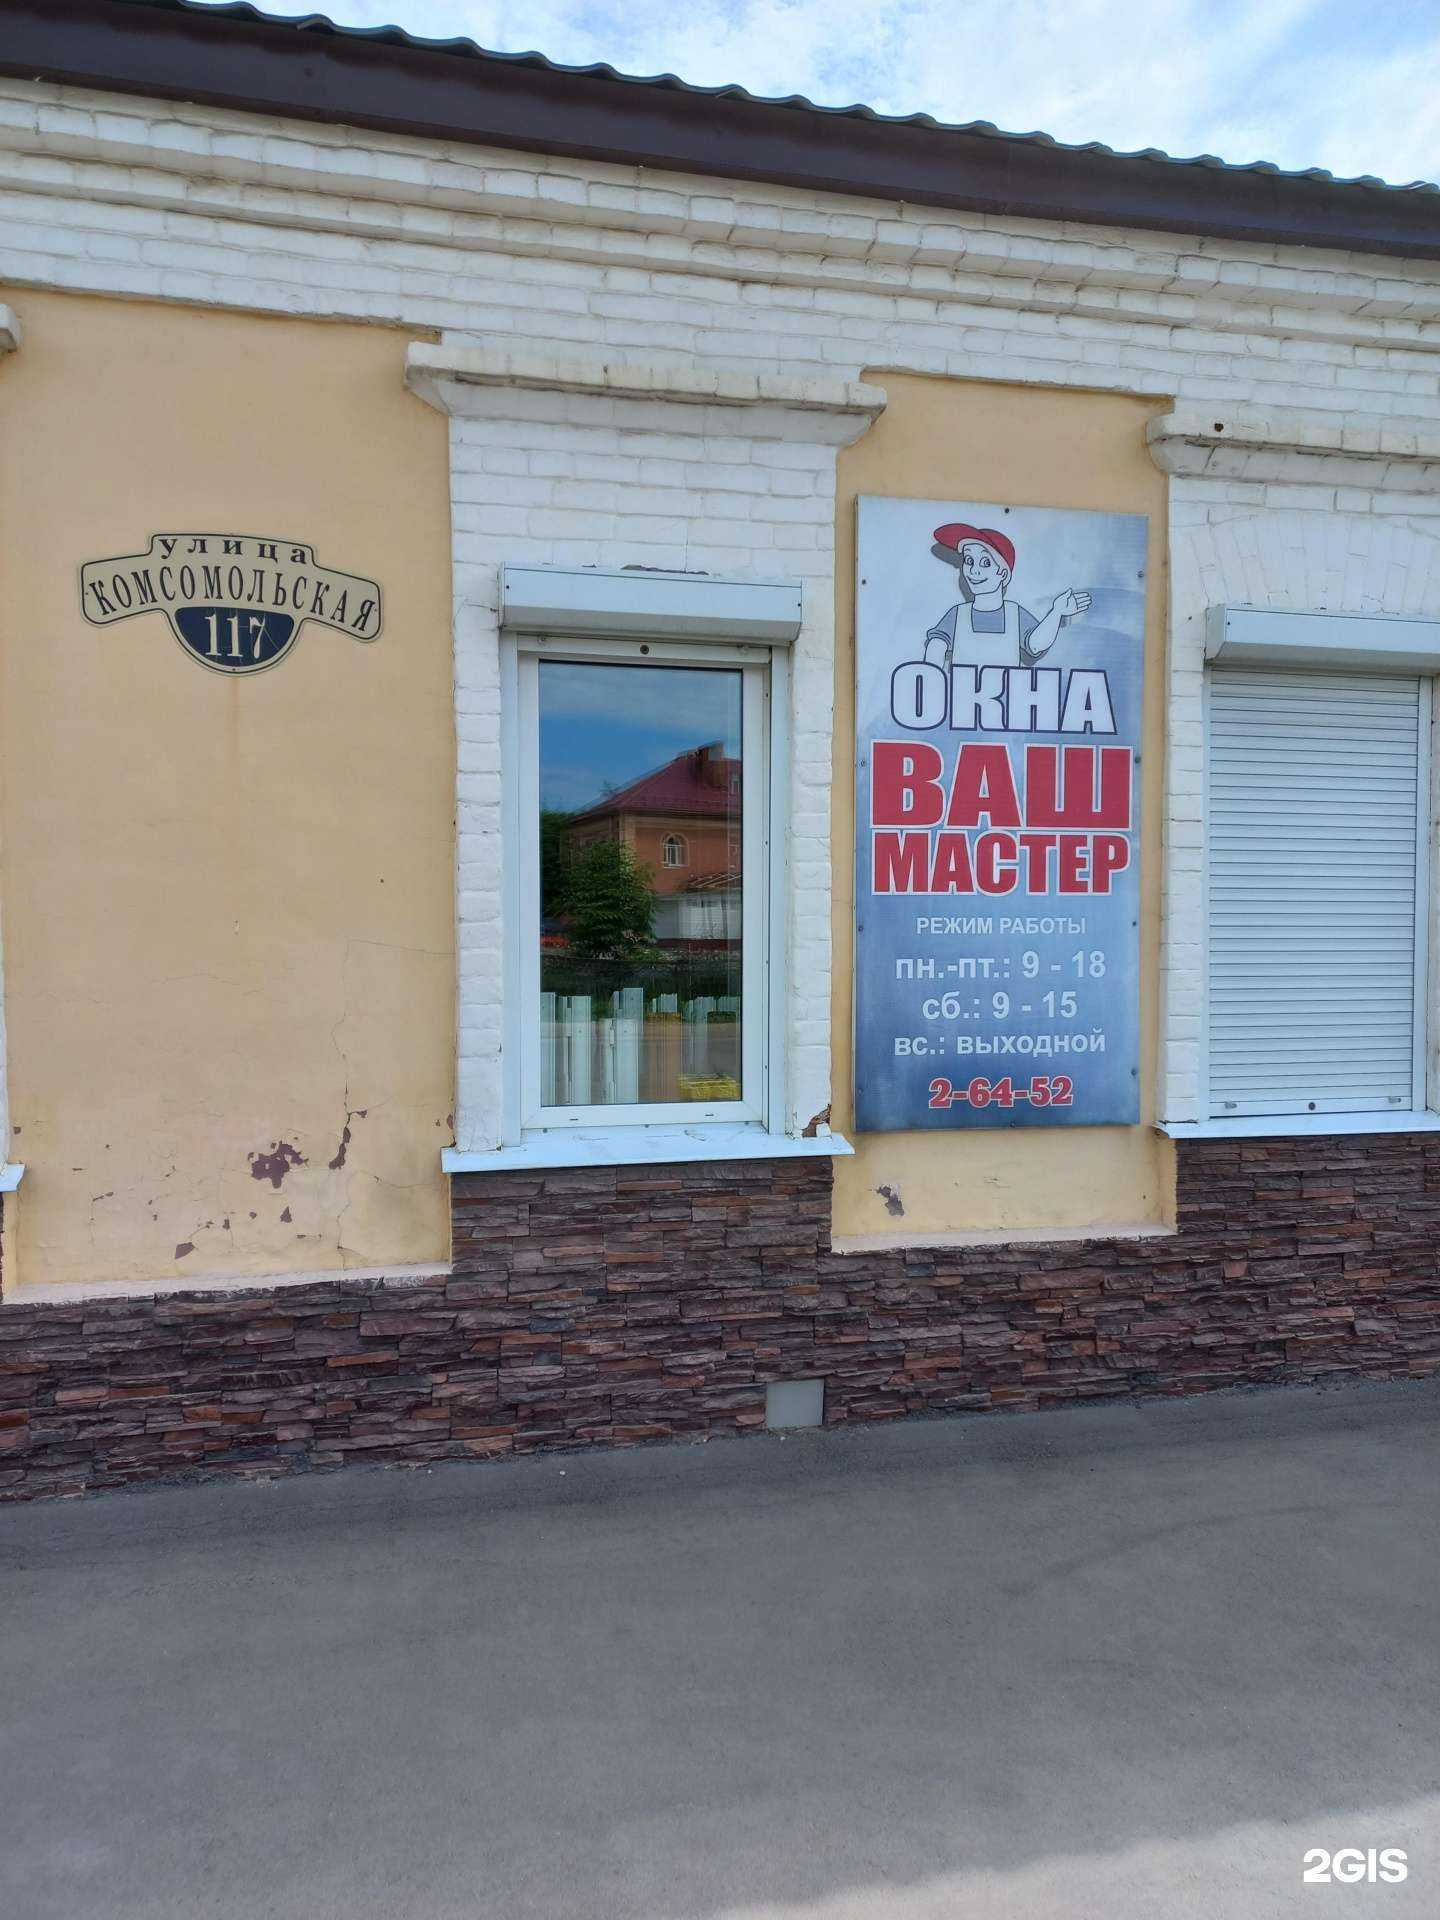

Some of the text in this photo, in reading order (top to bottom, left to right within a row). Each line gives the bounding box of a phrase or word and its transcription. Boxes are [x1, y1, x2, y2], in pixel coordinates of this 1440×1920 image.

[159, 539, 308, 564] улица
[89, 565, 375, 632] КОМСОМОЛЬСКАЯ
[204, 613, 267, 658] 117
[891, 661, 1117, 735] ОКНА
[870, 740, 1134, 831] ВАШ
[872, 829, 1130, 897] МАСТЕР
[916, 917, 1087, 935] РЕЖИМ РАБОТЫ
[1021, 950, 1040, 978] 9
[1071, 950, 1106, 978] 18
[922, 991, 980, 1020] сб.:
[992, 991, 1010, 1019] 9
[1042, 991, 1078, 1018] 15
[957, 1027, 1105, 1057] выходной
[928, 1075, 1074, 1109] 2-64-52
